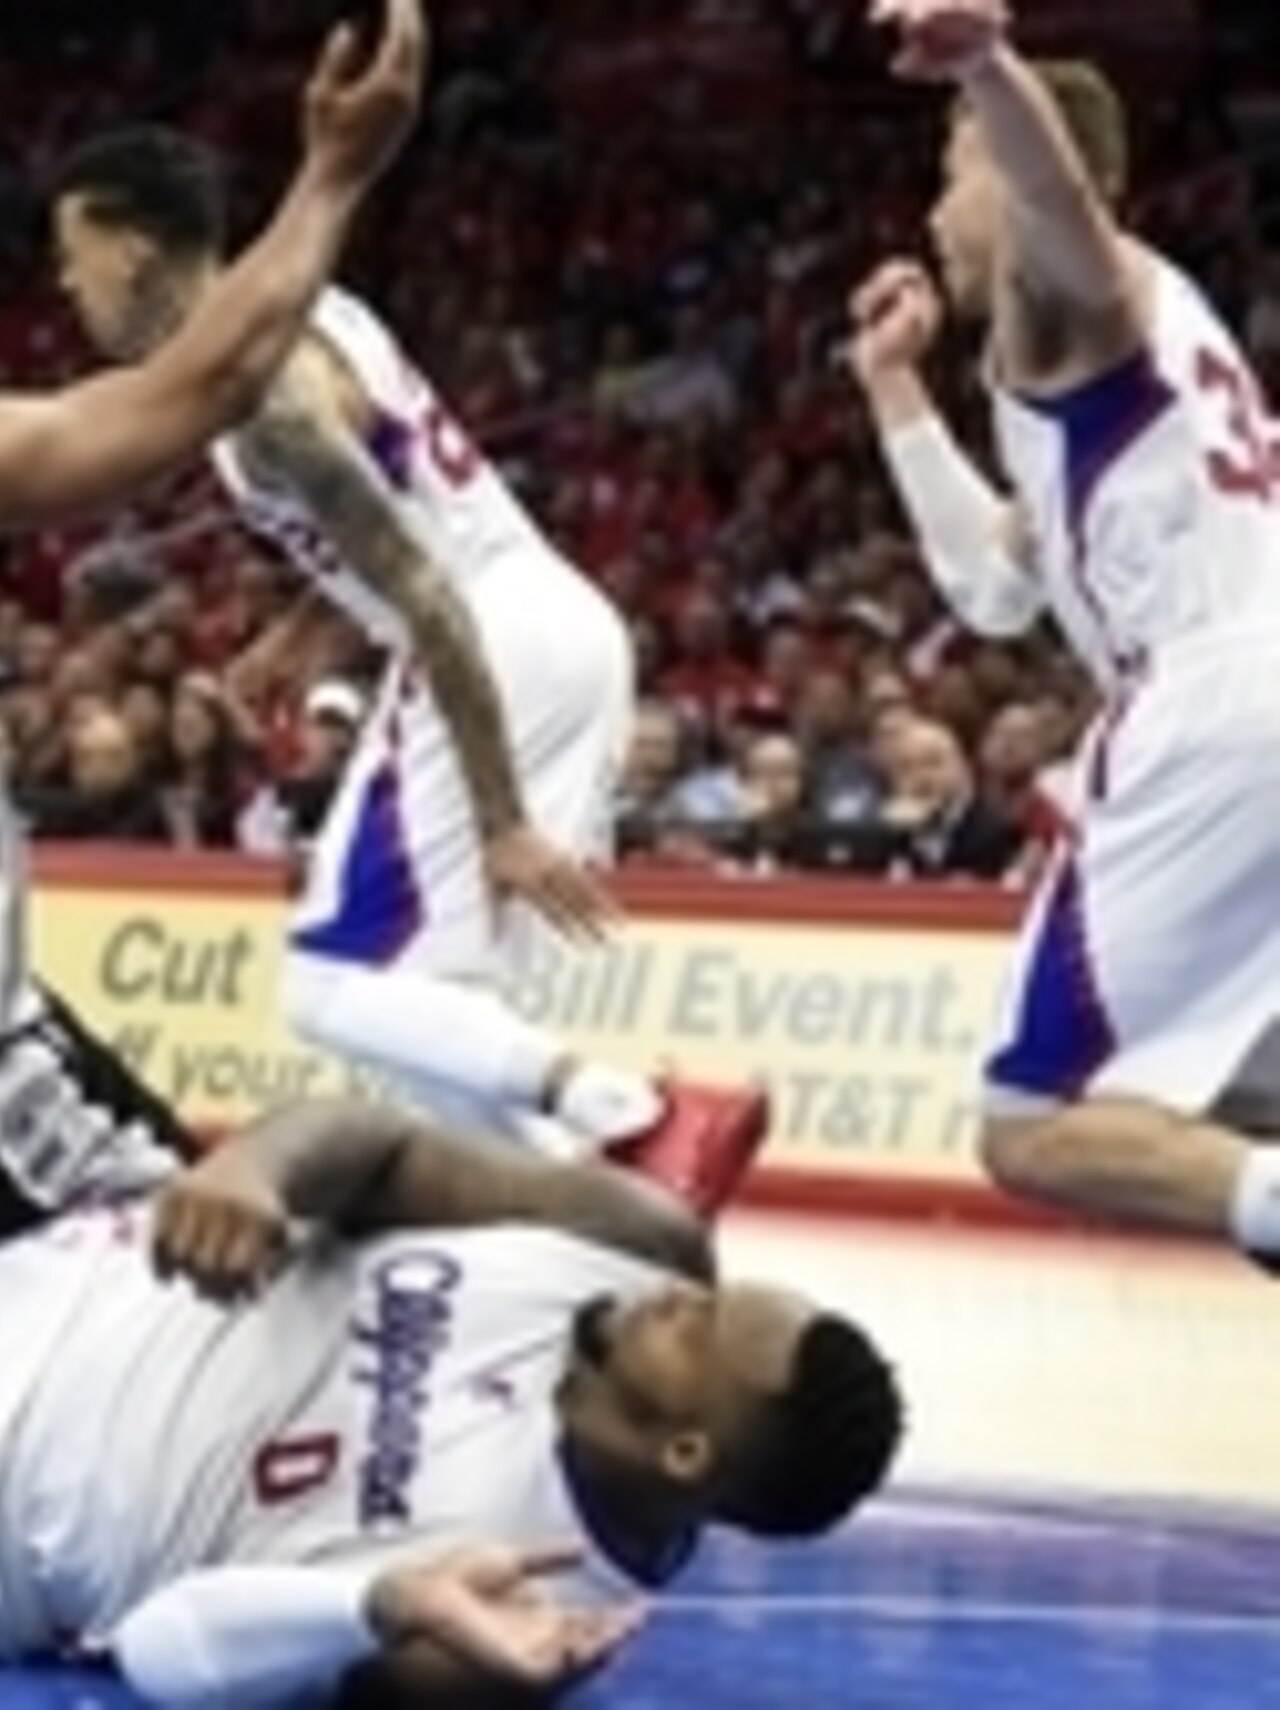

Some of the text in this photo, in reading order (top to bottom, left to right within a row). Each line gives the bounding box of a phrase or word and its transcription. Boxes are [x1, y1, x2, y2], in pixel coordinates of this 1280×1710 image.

[99, 917, 253, 1005] Cut
[665, 944, 976, 1053] Event.
[782, 1072, 934, 1148] T&T
